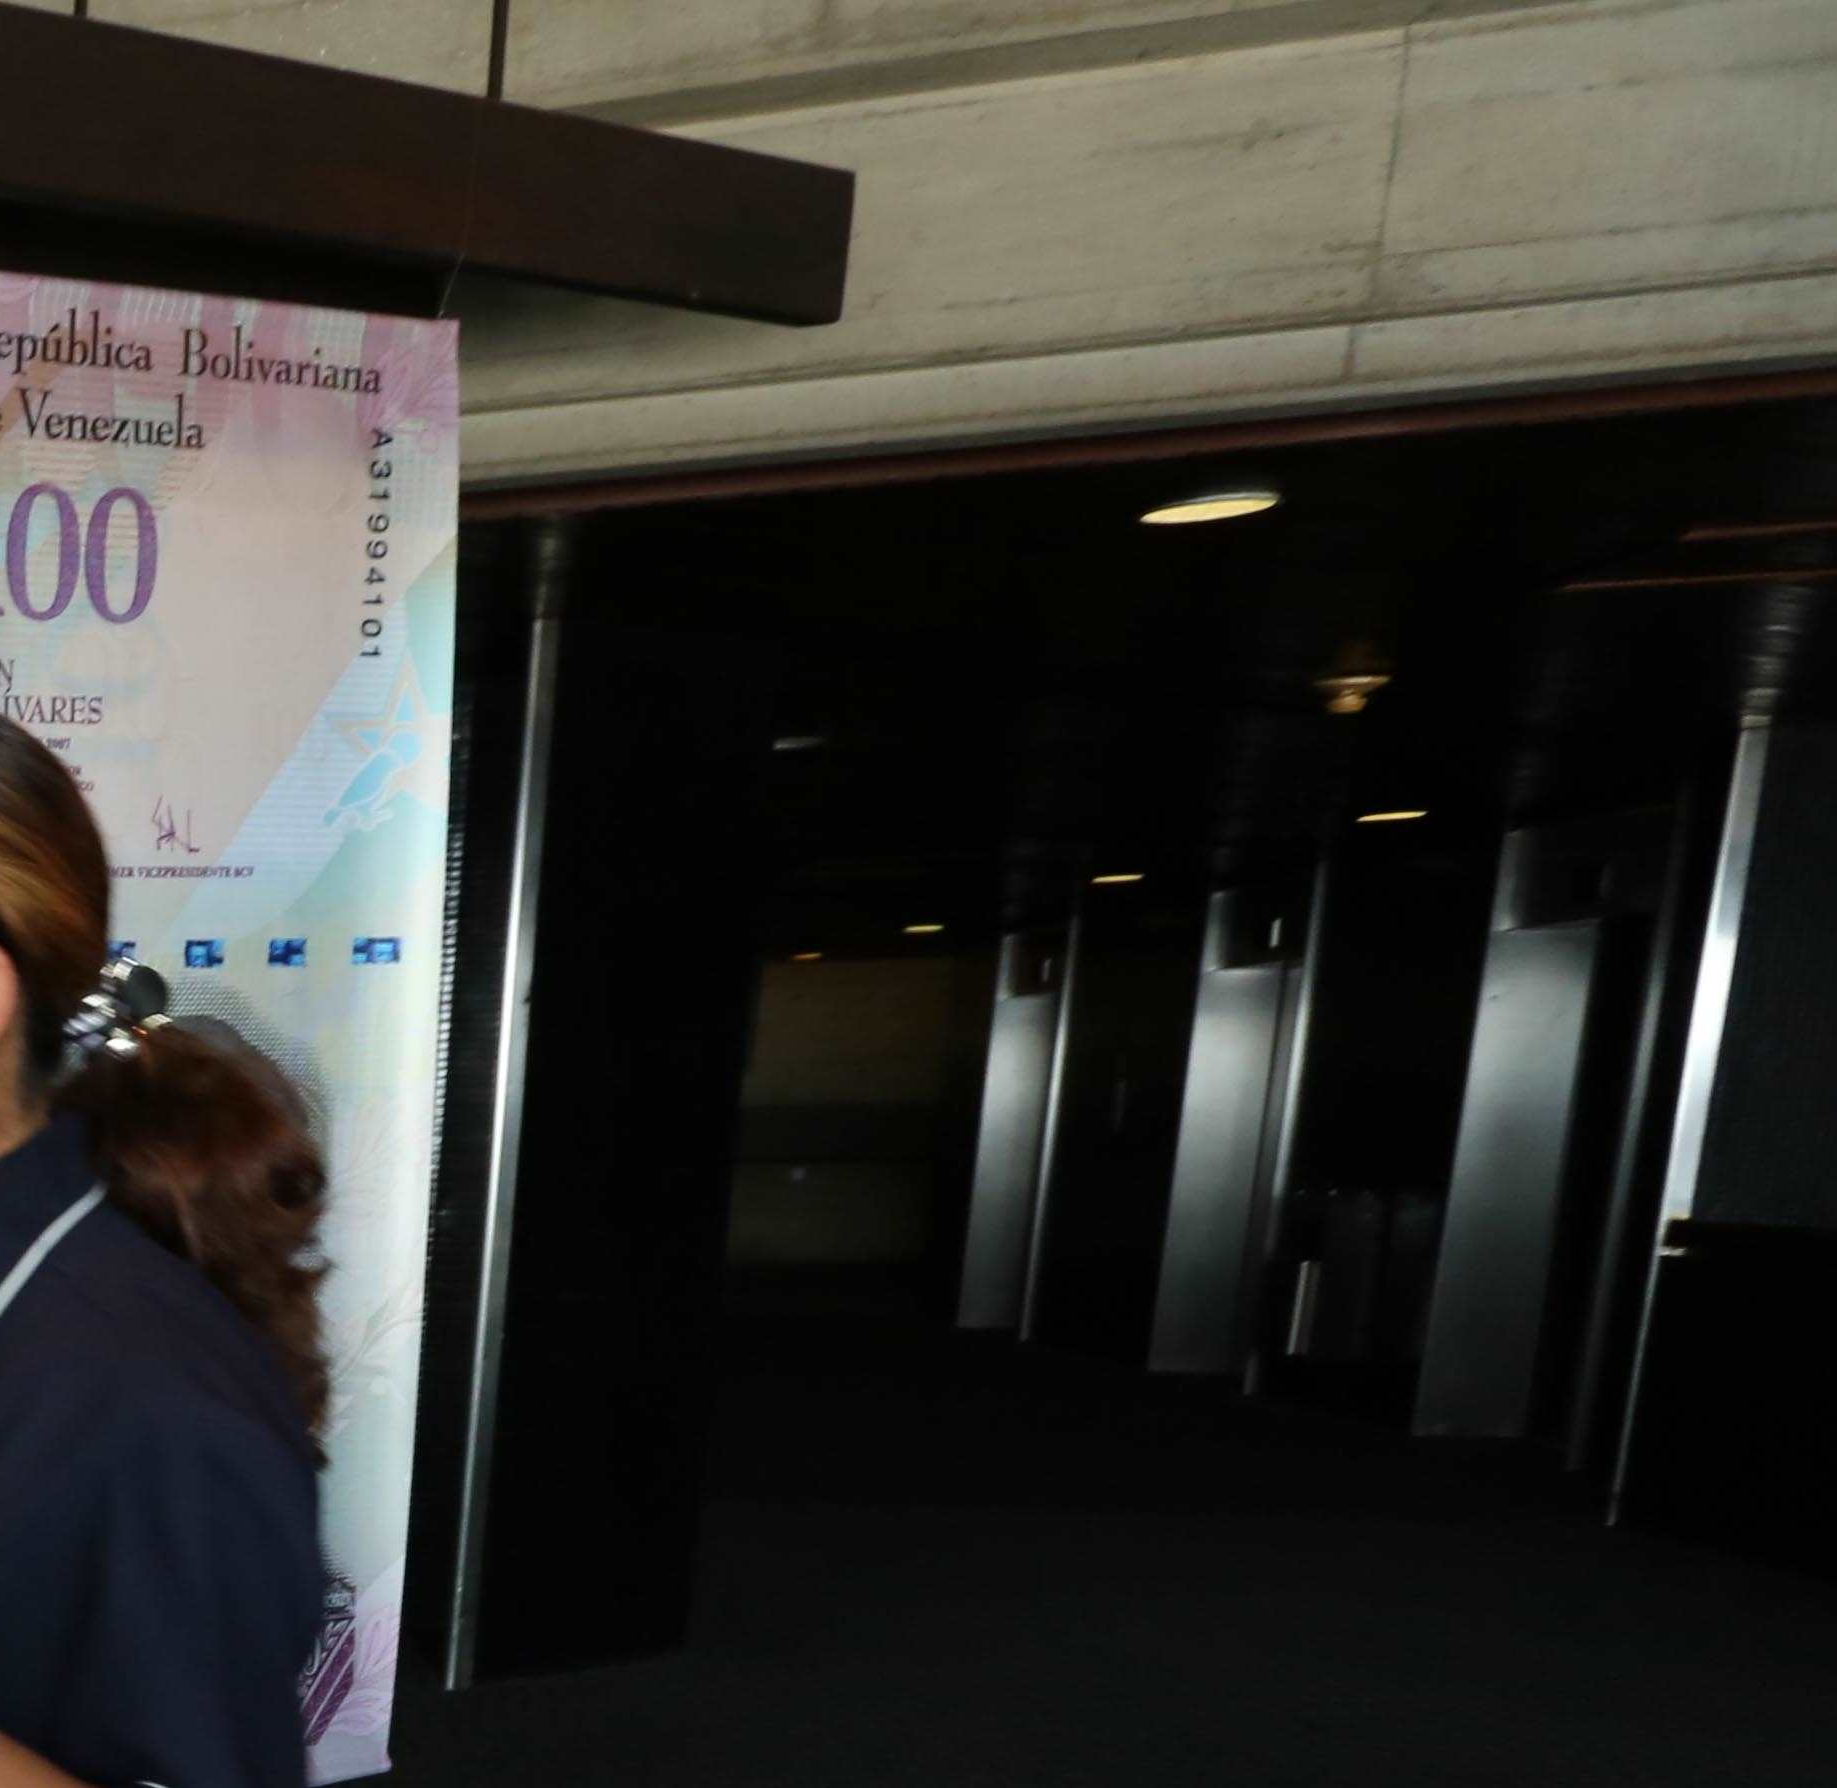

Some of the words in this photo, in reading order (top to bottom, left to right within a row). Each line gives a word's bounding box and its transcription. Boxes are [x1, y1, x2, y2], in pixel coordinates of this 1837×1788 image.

[180, 323, 382, 395] Bolivariana
[18, 387, 206, 450] Venezuela
[360, 428, 392, 659] A31994101
